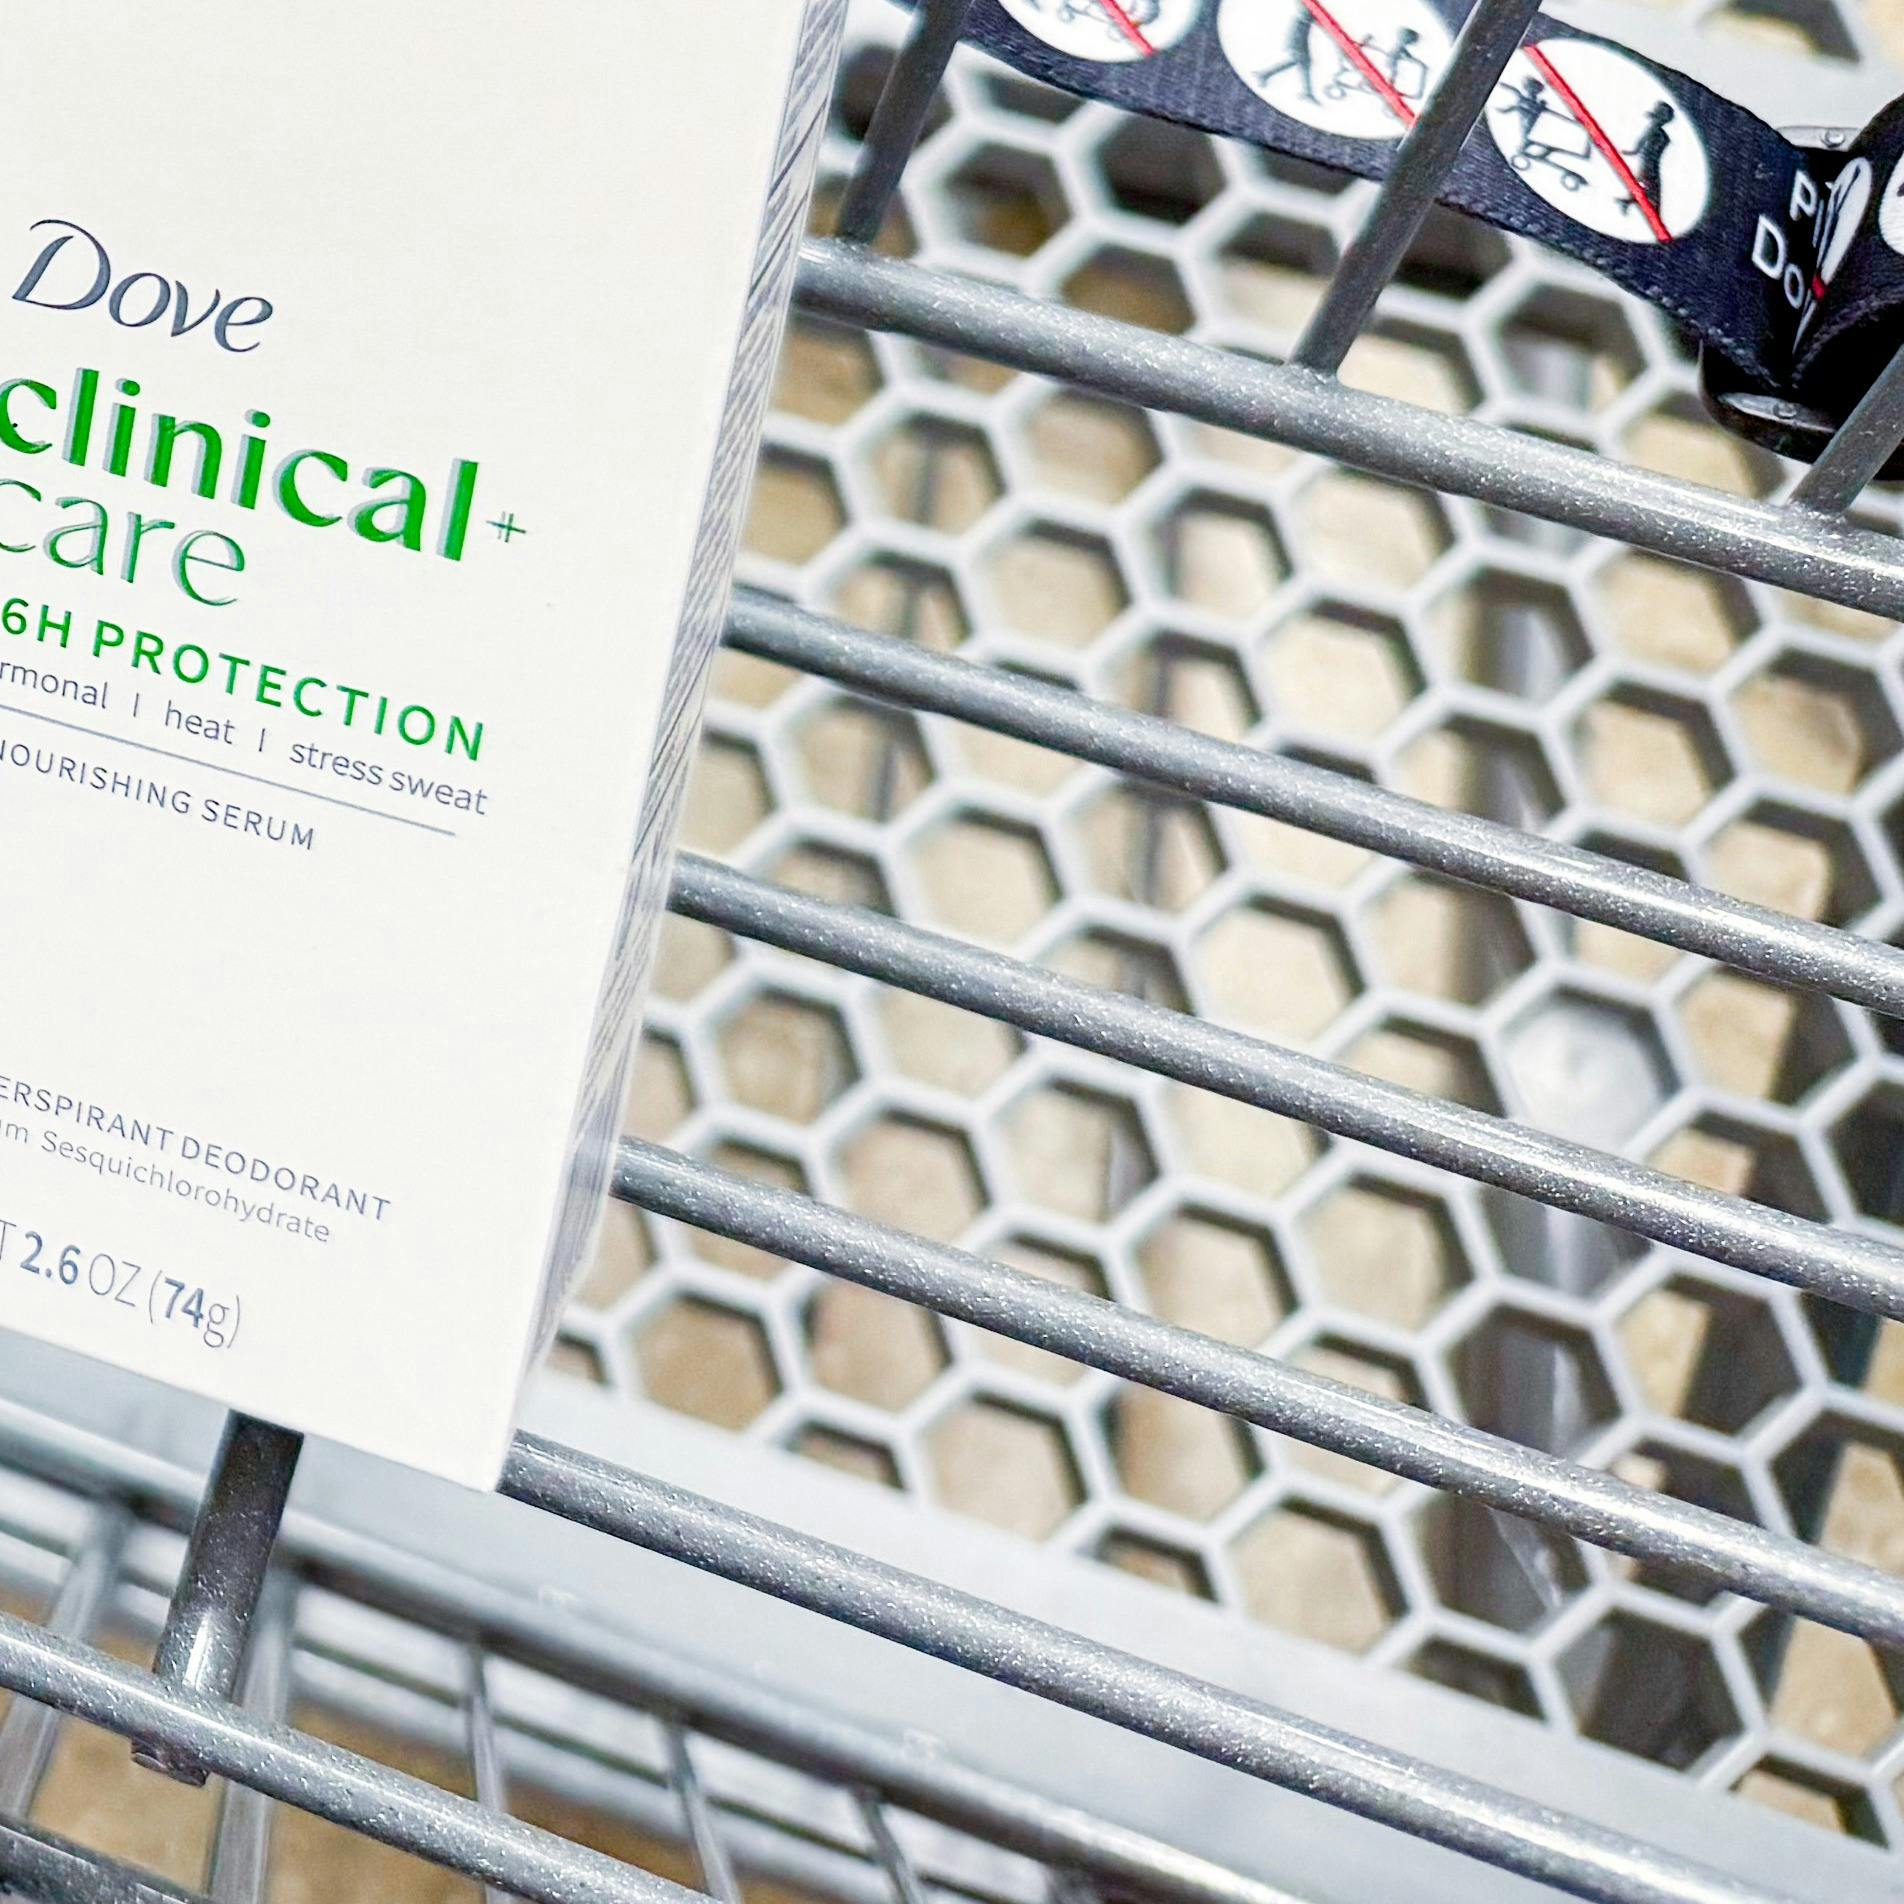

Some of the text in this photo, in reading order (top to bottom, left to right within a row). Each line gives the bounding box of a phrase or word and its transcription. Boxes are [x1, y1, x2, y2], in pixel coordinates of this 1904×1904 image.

[11, 218, 274, 353] Dove
[91, 618, 485, 762] PROTECTION
[164, 699, 235, 747] heat
[290, 741, 383, 787] stress
[388, 766, 489, 816] sweat
[200, 798, 315, 853] SERUM
[41, 1128, 331, 1244] Sesquichlorohydrate
[180, 1135, 392, 1222] DEODORANT
[19, 1229, 79, 1287] 2.6
[88, 1251, 142, 1310] OZ
[148, 1267, 241, 1349] (74g)
